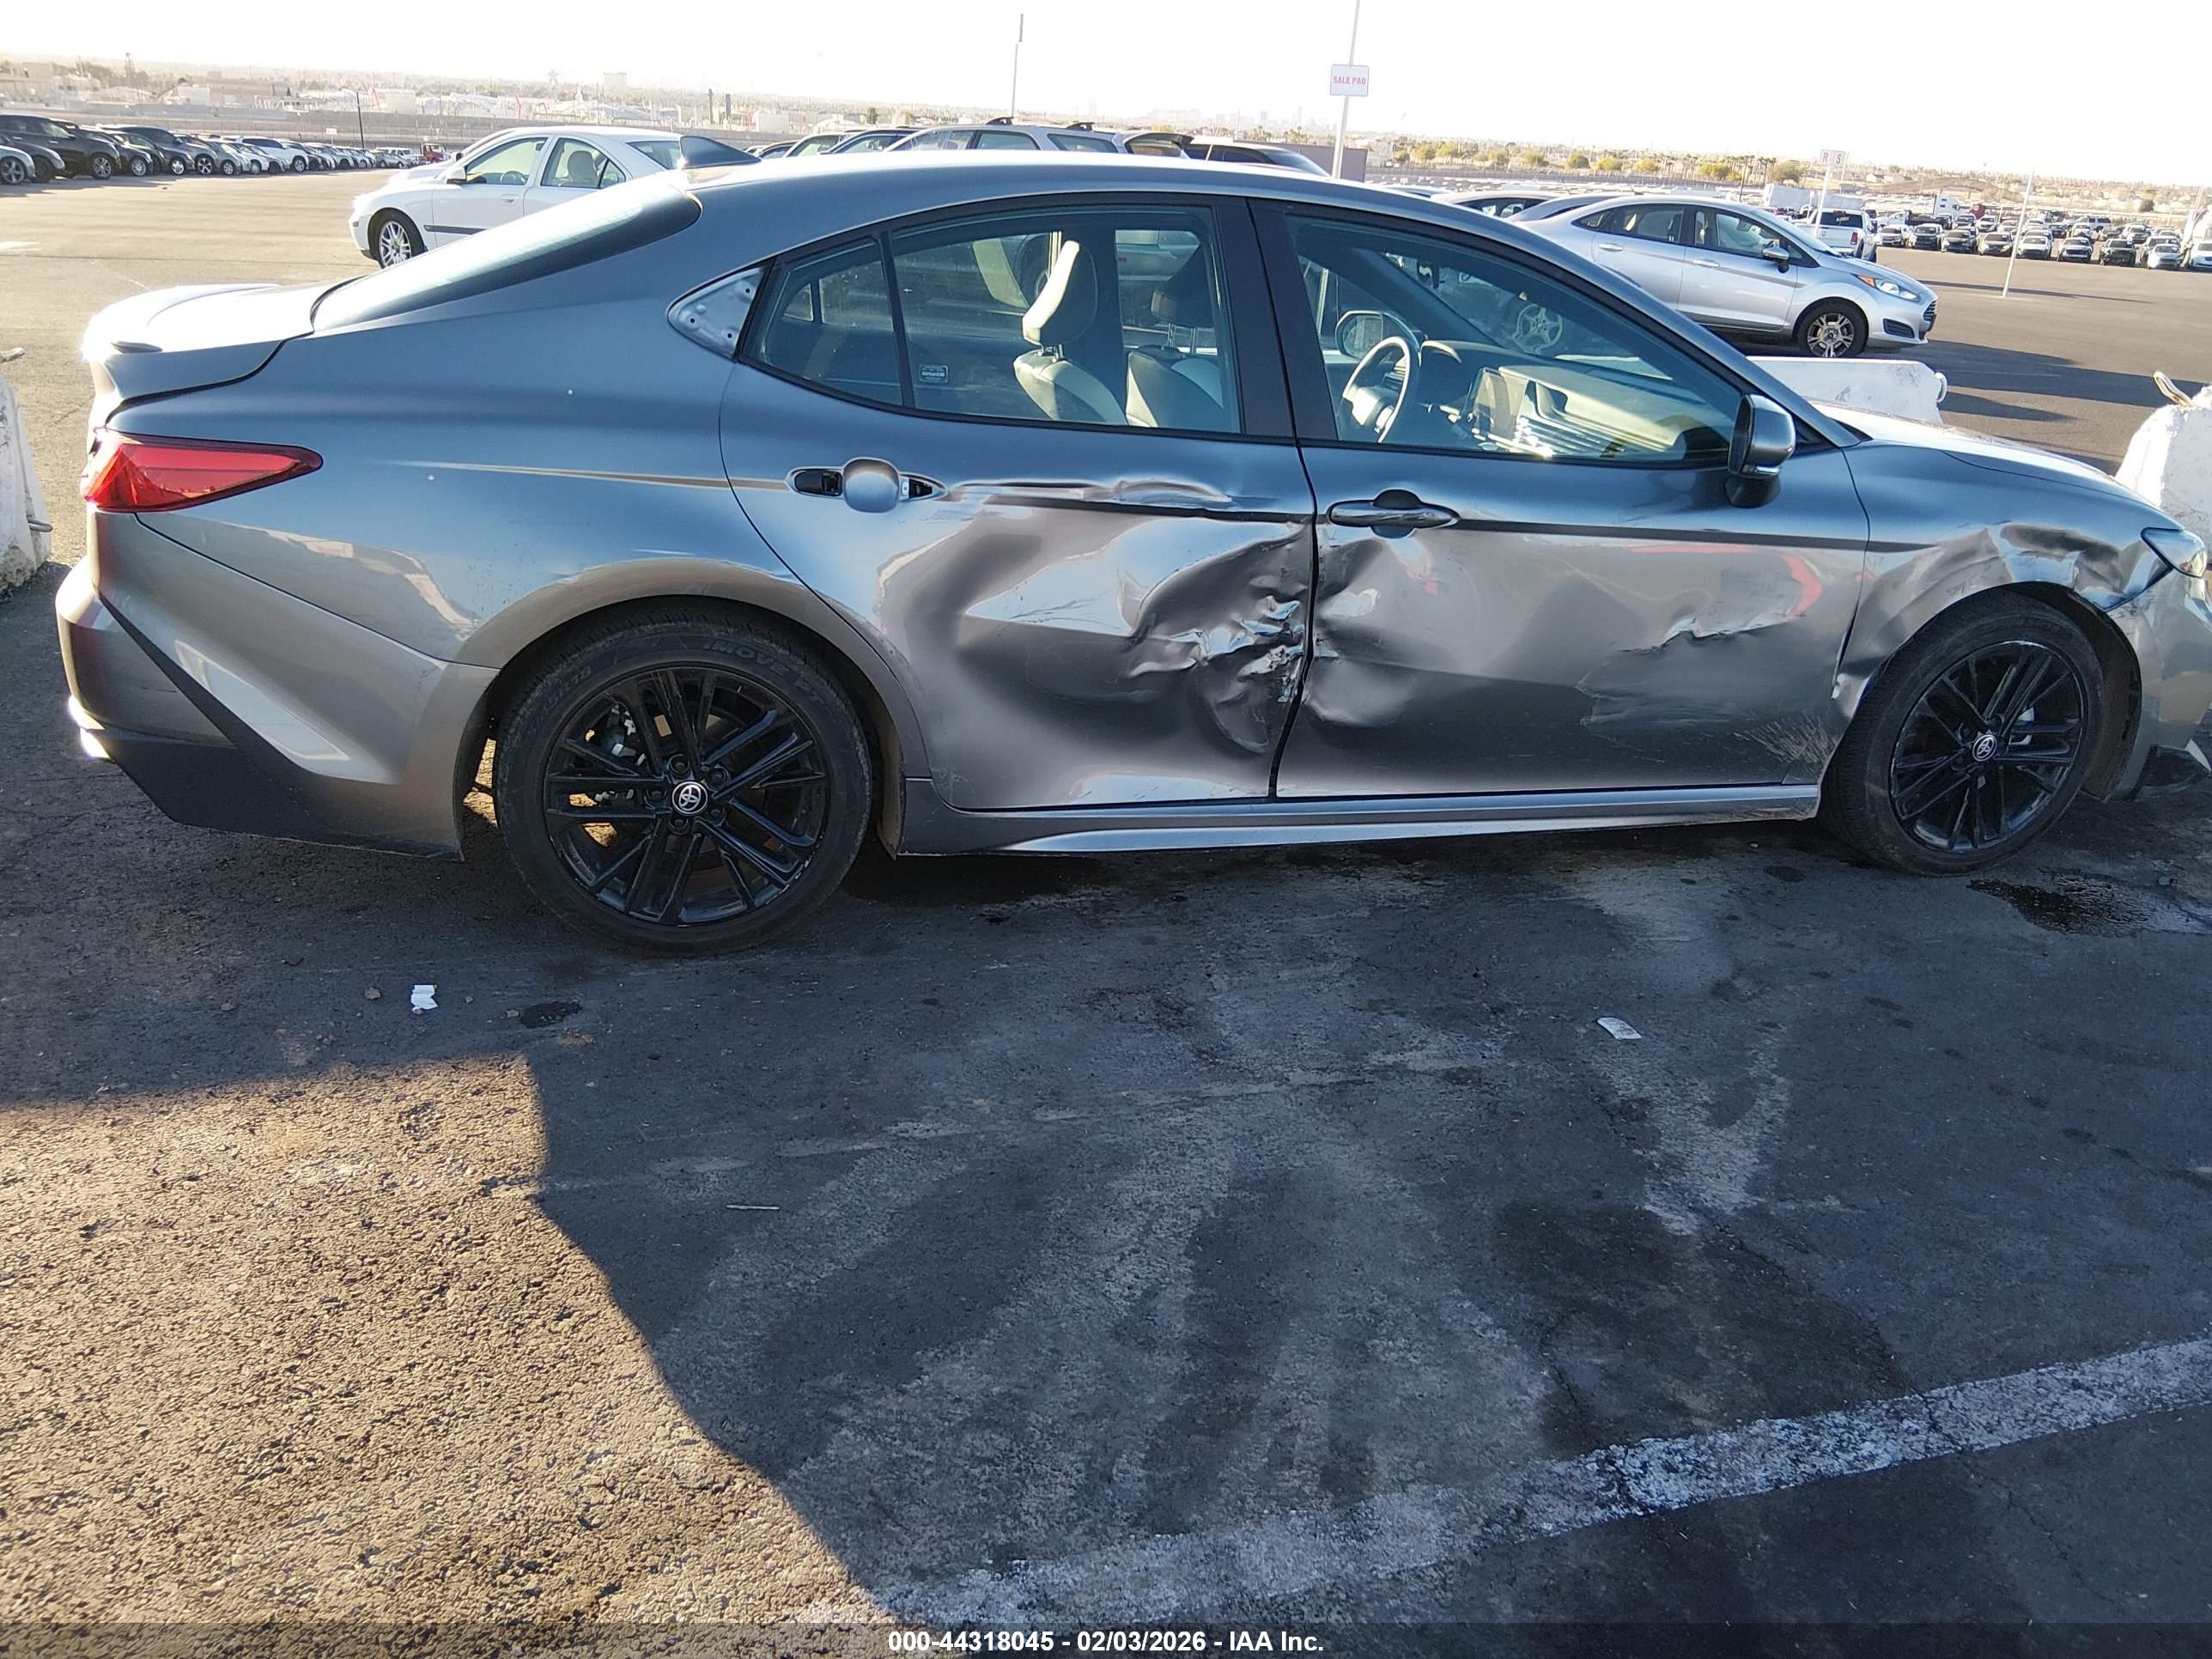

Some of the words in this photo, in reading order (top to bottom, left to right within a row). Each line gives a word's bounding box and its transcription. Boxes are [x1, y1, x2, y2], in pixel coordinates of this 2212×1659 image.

[1333, 76, 1350, 84] SALE
[1822, 152, 1829, 164] R
[1835, 153, 1842, 165] S
